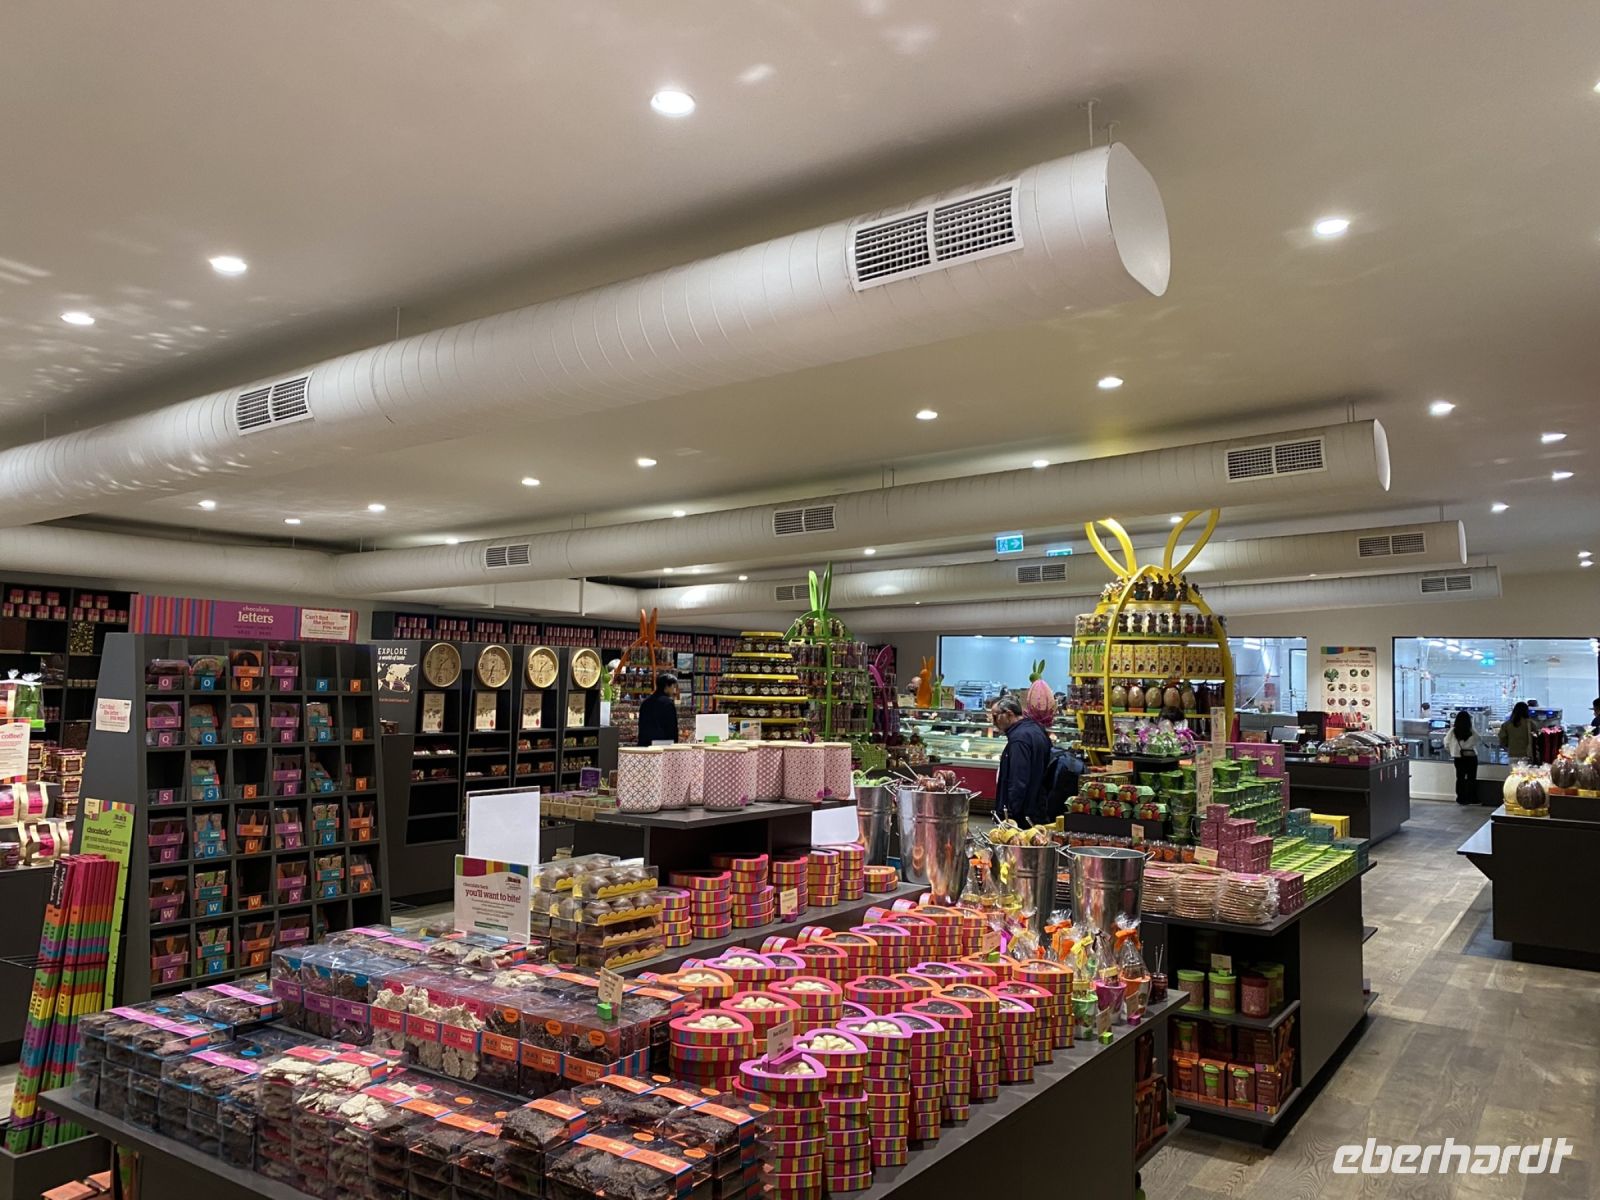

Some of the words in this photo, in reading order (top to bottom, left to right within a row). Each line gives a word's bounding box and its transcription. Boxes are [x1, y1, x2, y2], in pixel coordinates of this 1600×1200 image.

[238, 611, 274, 624] letters
[466, 889, 482, 897] you'll
[484, 892, 499, 900] want
[507, 894, 520, 903] bite!
[500, 1043, 513, 1052] bark
[542, 1056, 555, 1065] bark
[586, 1069, 600, 1078] bark
